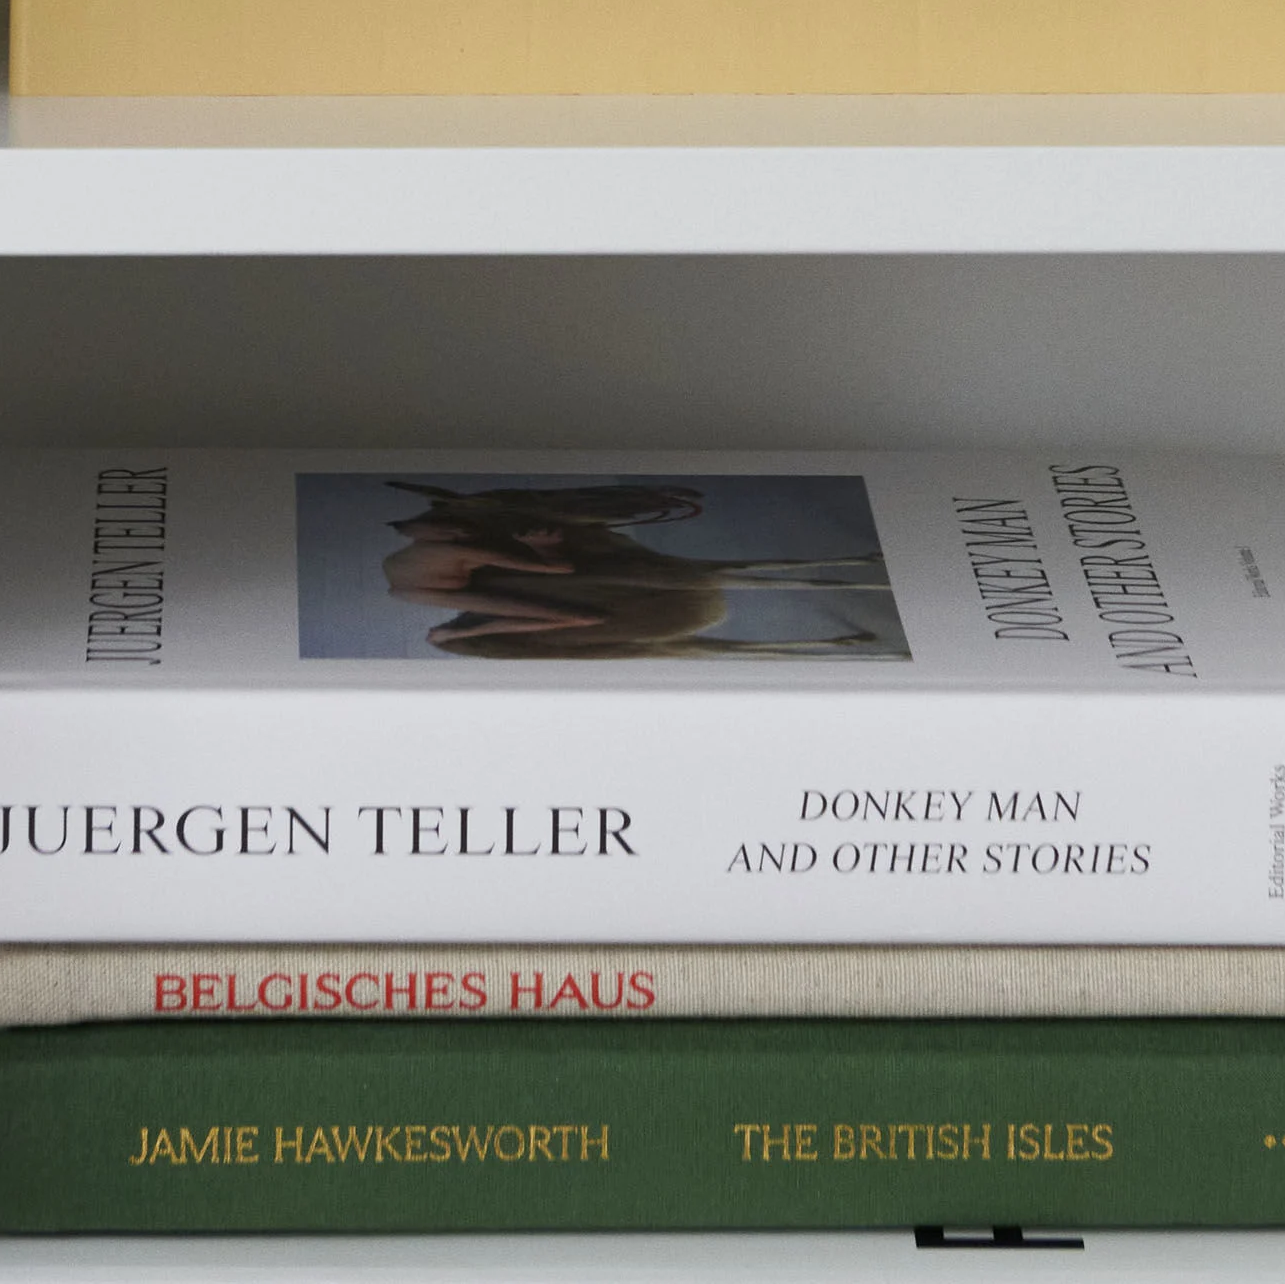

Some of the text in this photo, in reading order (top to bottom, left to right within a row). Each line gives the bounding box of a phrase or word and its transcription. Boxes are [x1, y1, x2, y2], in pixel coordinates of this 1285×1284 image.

[85, 465, 168, 666] JUERGEN TELLER
[953, 497, 1069, 641] DONKEY MAN
[1048, 464, 1198, 679] AND OTHER STORIES
[799, 791, 1083, 822] DONKEY MAN
[358, 808, 634, 855] TELLER
[1267, 765, 1285, 900] Editorial Works
[733, 843, 1150, 873] AND OTHER STORIES
[153, 969, 657, 1013] BELGISCHES HAUS
[129, 1124, 609, 1166] JAMIE HAWKESWORTH
[734, 1123, 1114, 1161] THE BRITISH ISLES
